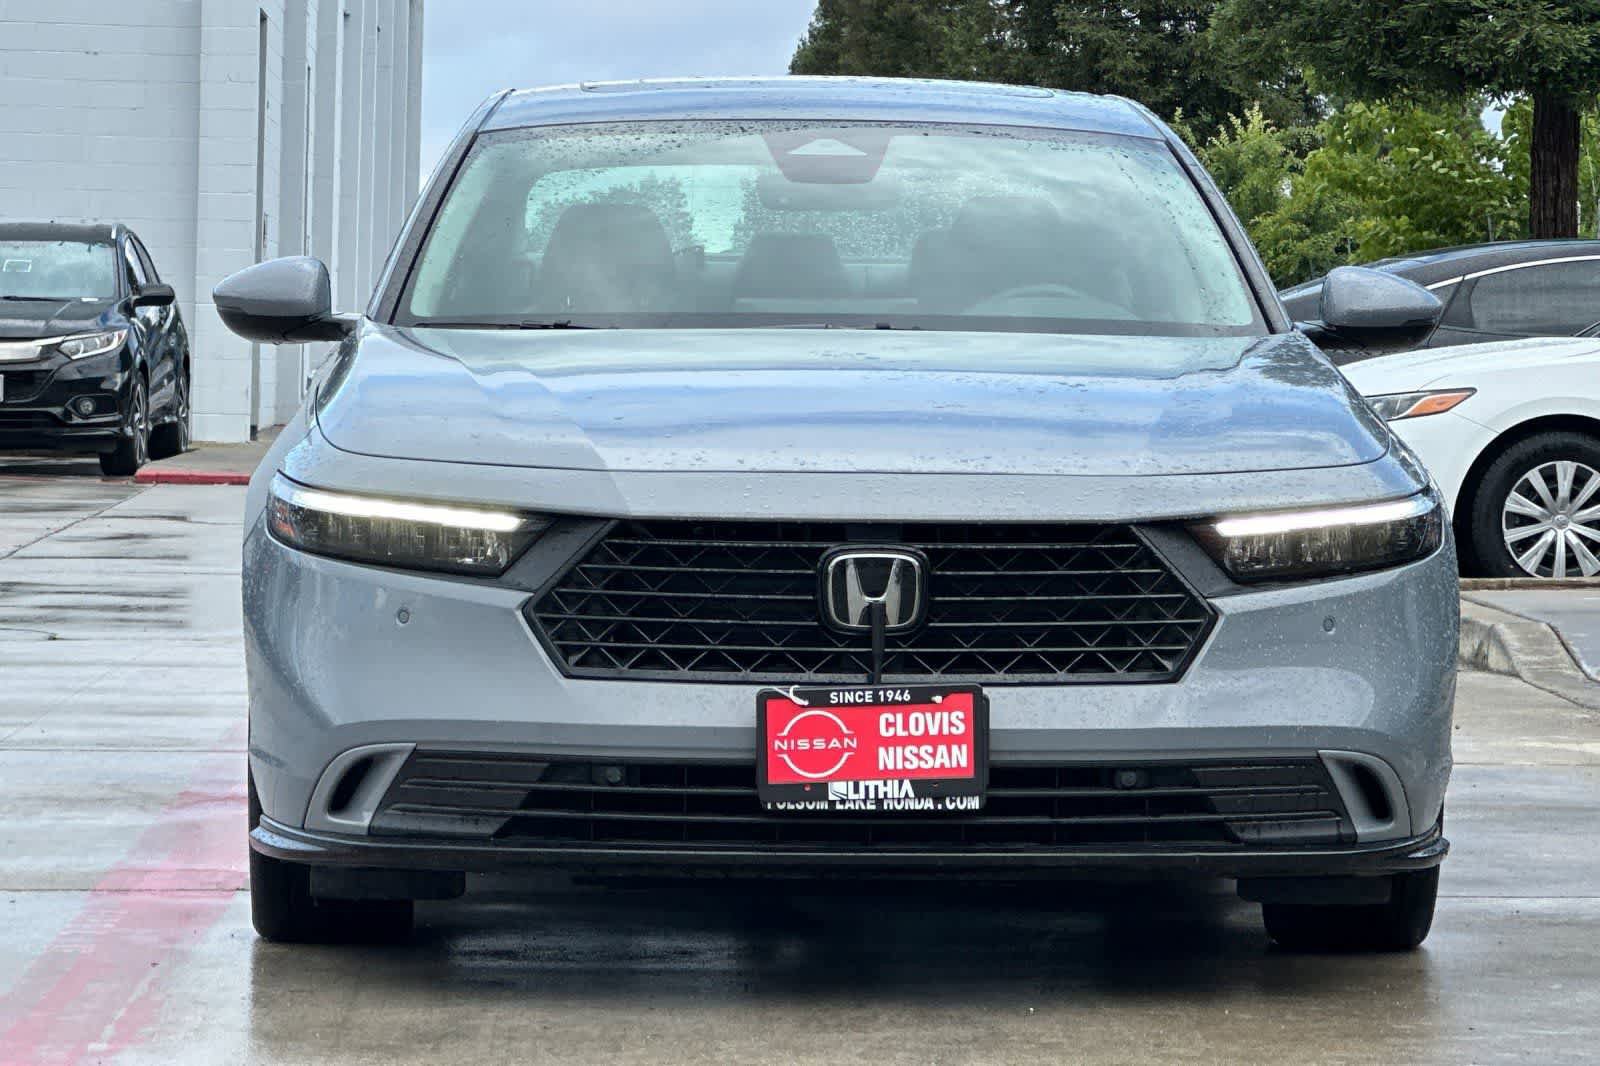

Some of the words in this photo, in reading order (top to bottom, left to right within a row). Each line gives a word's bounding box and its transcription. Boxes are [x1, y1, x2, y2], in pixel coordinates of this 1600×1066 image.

[829, 690, 873, 704] SINCE
[878, 689, 912, 703] 1946
[879, 711, 966, 738] CLOVIS
[774, 737, 858, 751] NISSAN
[878, 744, 968, 772] NISSAN
[848, 779, 915, 800] LITHIA
